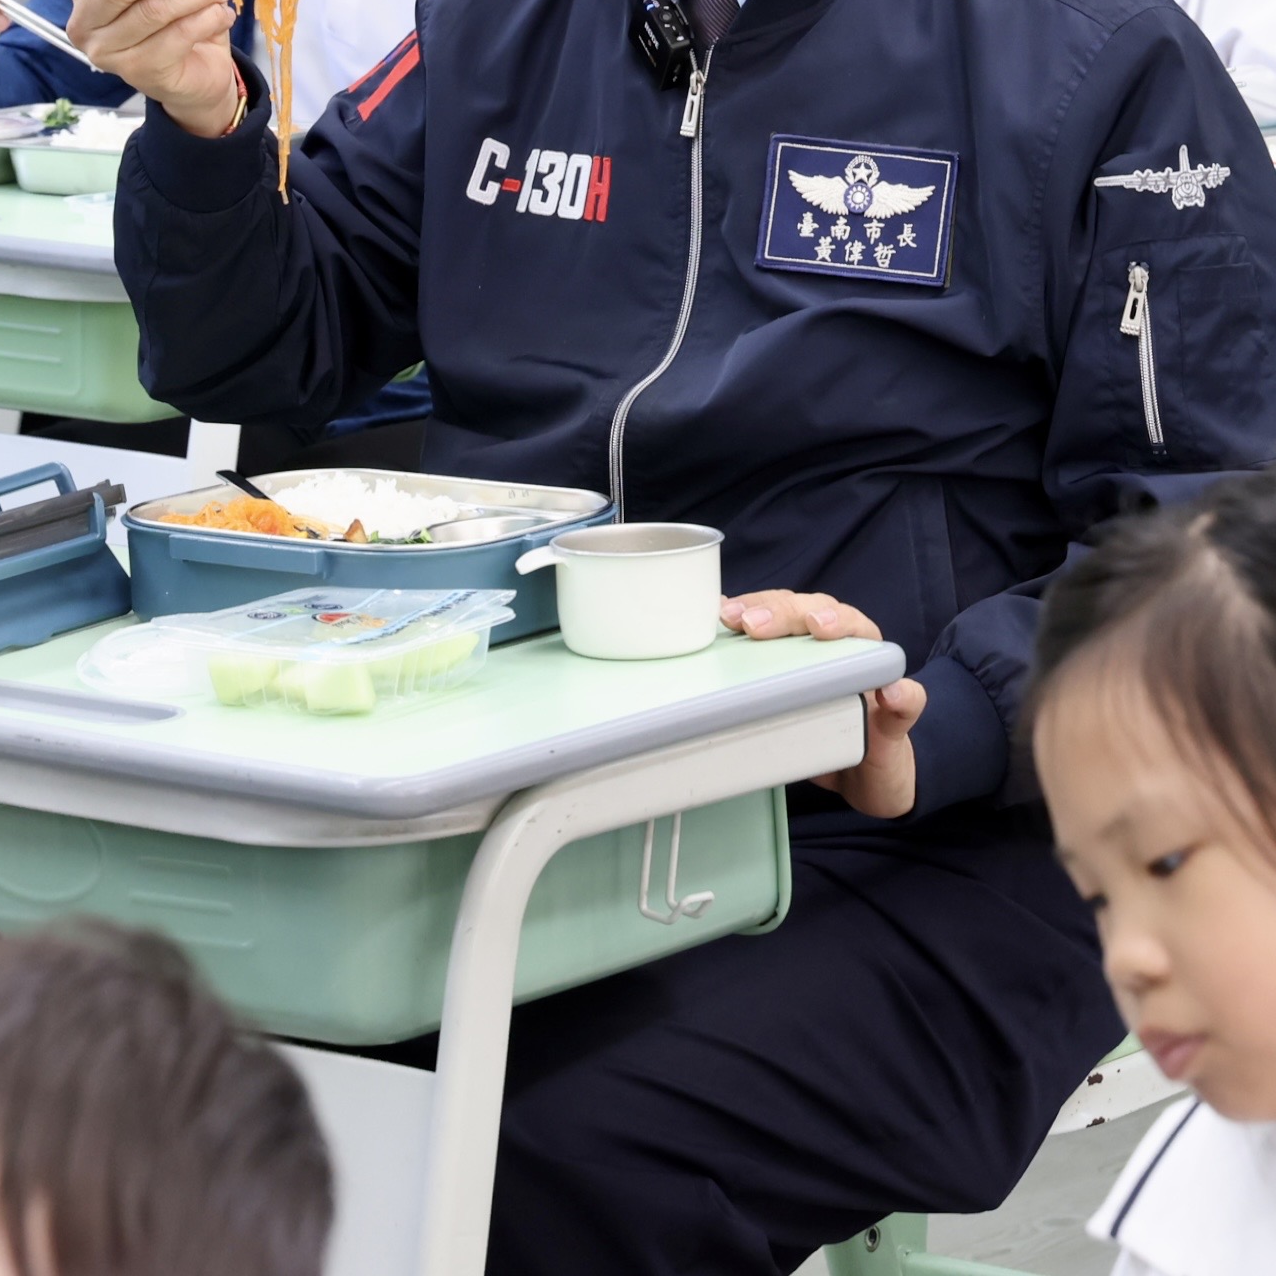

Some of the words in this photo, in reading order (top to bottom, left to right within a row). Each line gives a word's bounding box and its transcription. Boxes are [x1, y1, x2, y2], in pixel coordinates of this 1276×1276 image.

[466, 137, 612, 222] C-130H
[797, 212, 917, 248] 臺南市長
[814, 236, 897, 268] 黃偉哲
